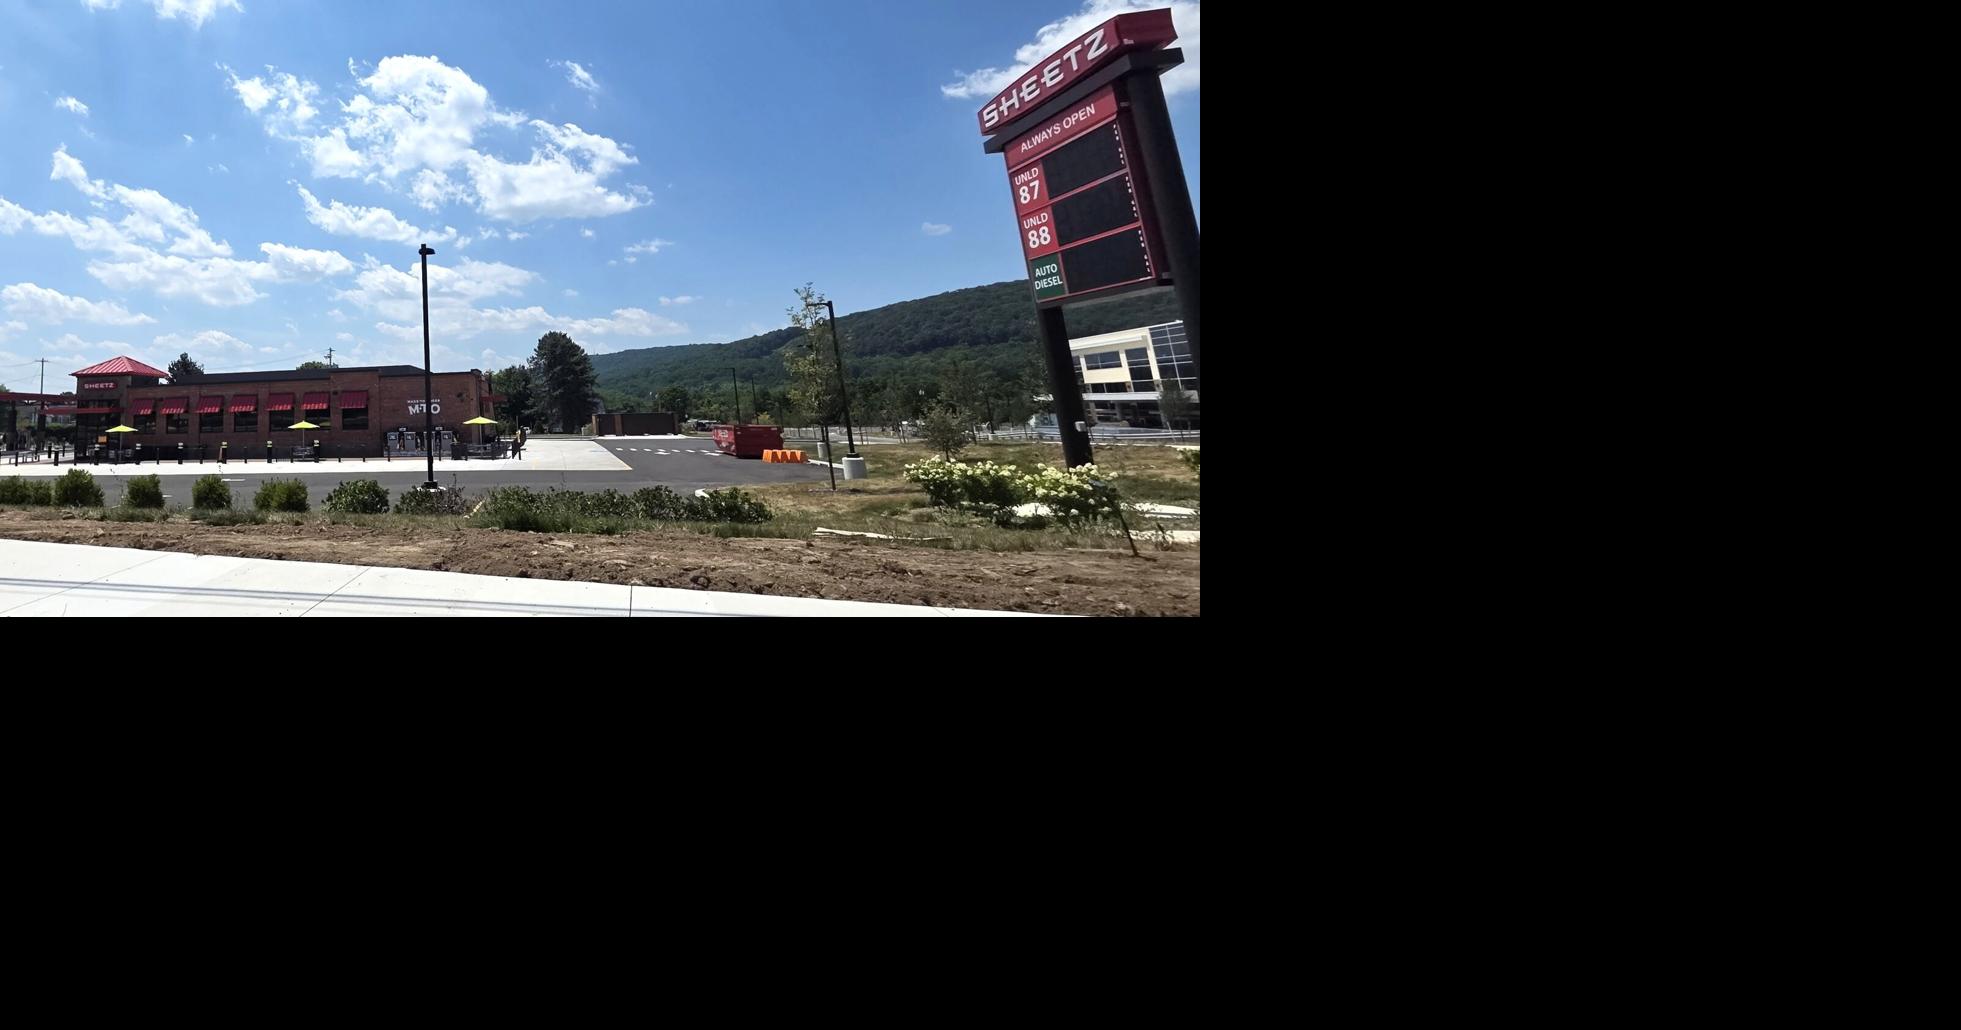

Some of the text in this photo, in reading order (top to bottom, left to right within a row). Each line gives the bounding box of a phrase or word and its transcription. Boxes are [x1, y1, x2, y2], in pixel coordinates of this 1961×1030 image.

[983, 28, 1109, 128] SHEETZ
[1021, 103, 1096, 153] ALWAYS OPEN
[1014, 167, 1039, 185] UNLD
[1019, 179, 1040, 204] 87
[1023, 212, 1048, 229] UNLD
[1028, 226, 1051, 249] 88
[1035, 263, 1058, 277] AUTO
[1034, 276, 1063, 290] DIESEL
